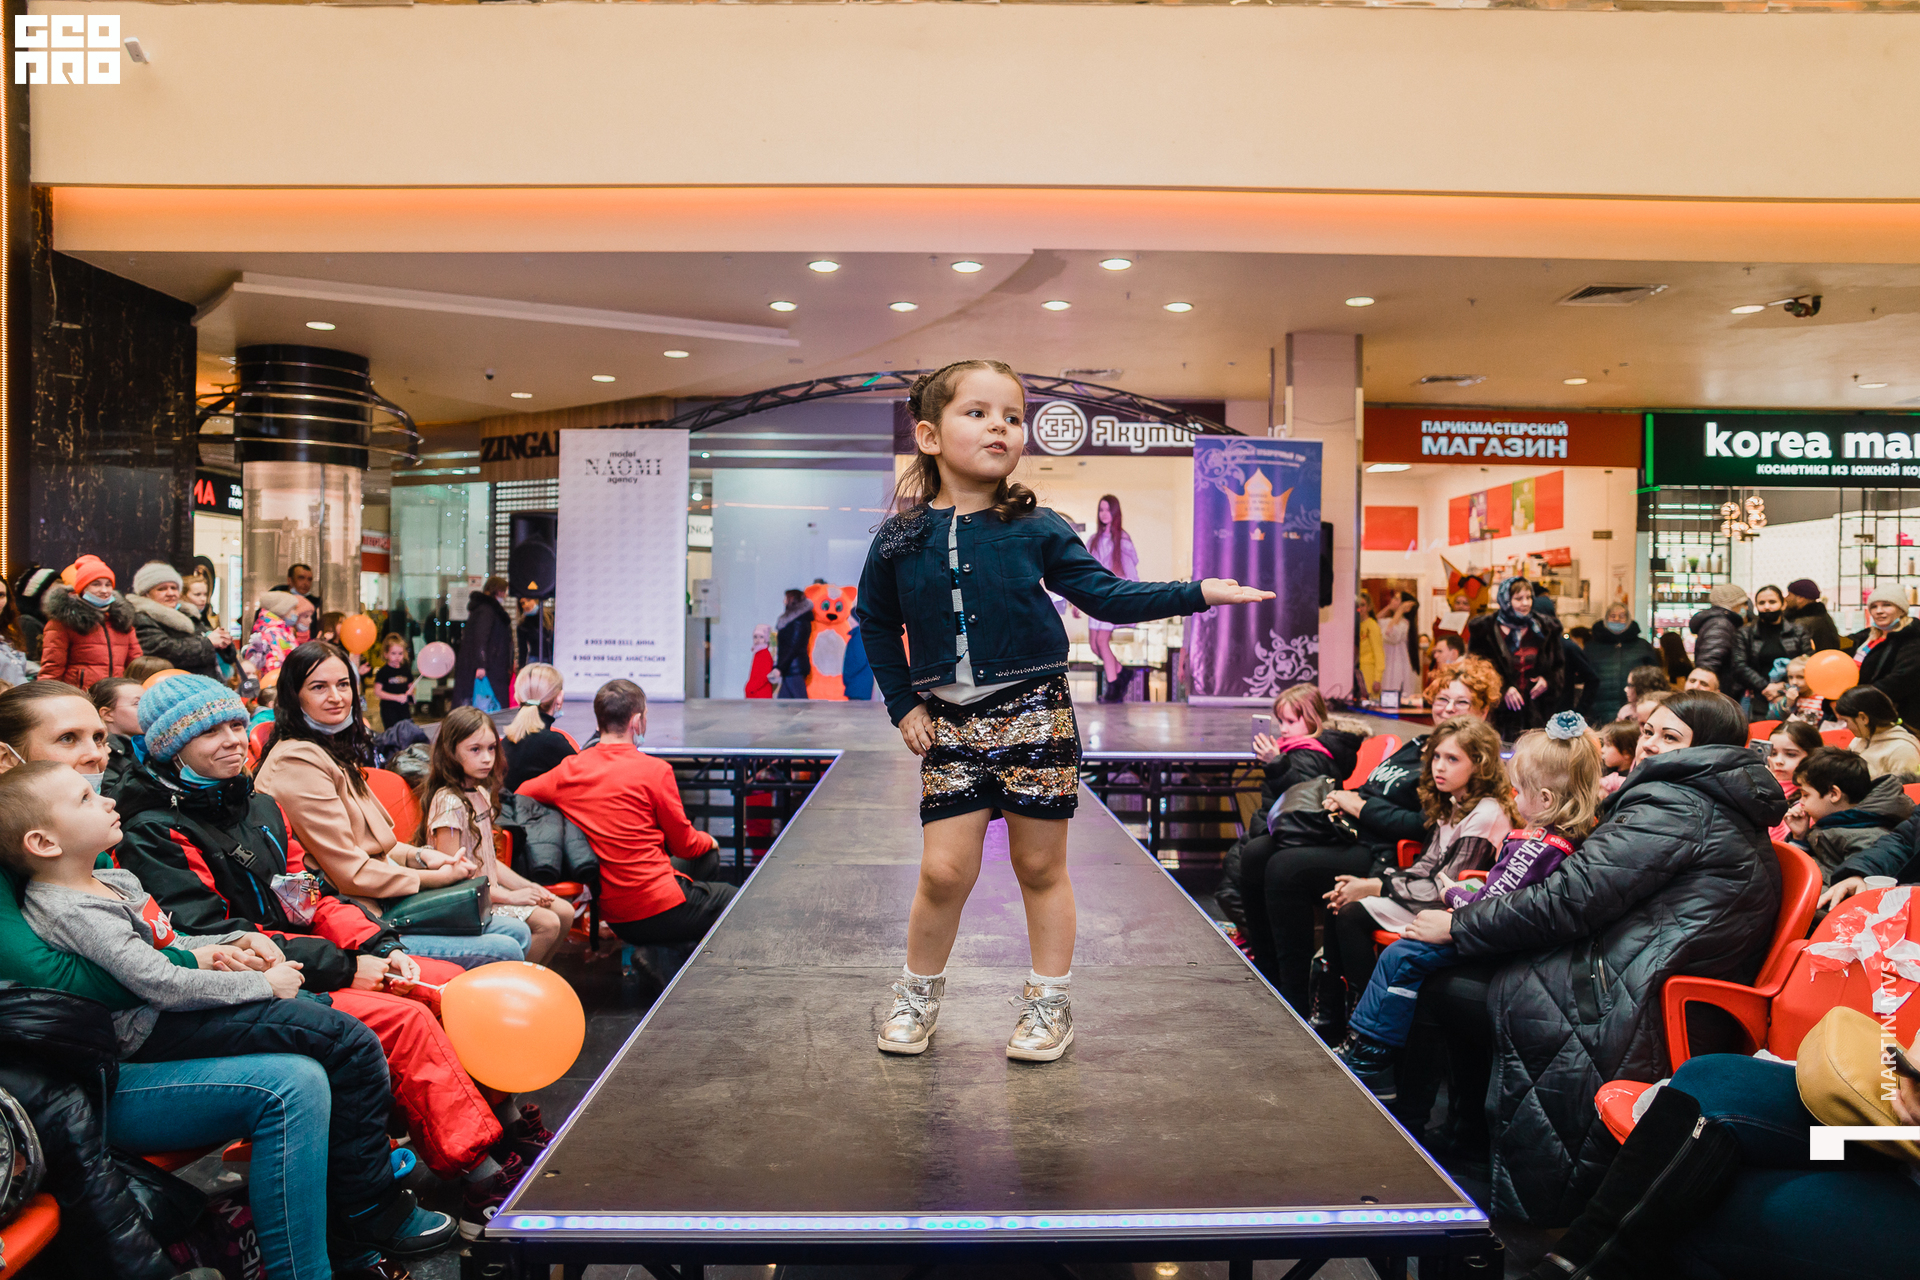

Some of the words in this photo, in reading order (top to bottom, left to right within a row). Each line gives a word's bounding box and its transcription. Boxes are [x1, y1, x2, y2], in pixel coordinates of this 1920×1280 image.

[1421, 420, 1569, 436] ПАРИКМАСТЕРСКИЙ
[1421, 436, 1568, 458] МАГАЗИН
[1705, 422, 1833, 458] korea
[585, 459, 662, 476] NAOMI
[1756, 464, 1829, 476] косметика
[1831, 465, 1849, 476] из
[1850, 463, 1900, 477] южной
[1902, 465, 1920, 478] ко
